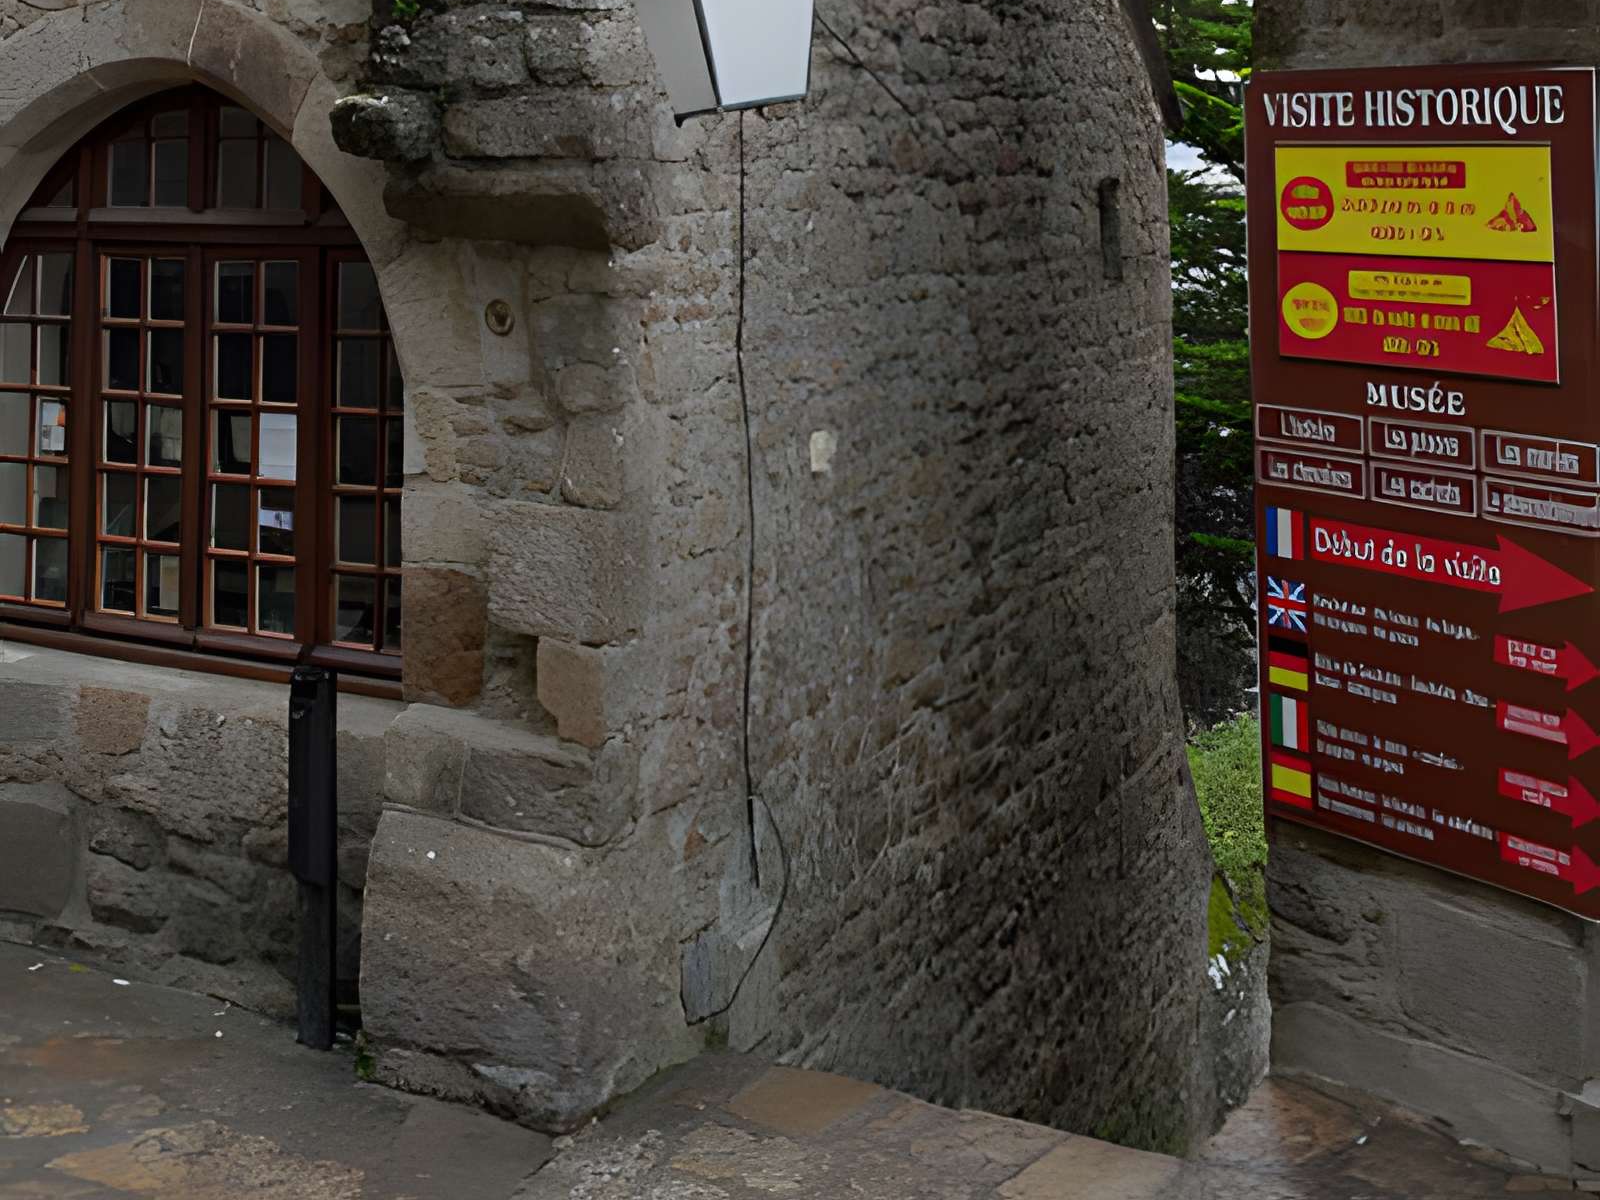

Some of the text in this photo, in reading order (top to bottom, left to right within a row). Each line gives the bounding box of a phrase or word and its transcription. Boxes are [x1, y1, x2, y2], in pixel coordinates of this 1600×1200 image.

[1263, 85, 1565, 135] VISITE HISTORIQUE
[1366, 381, 1466, 416] MUSÉE
